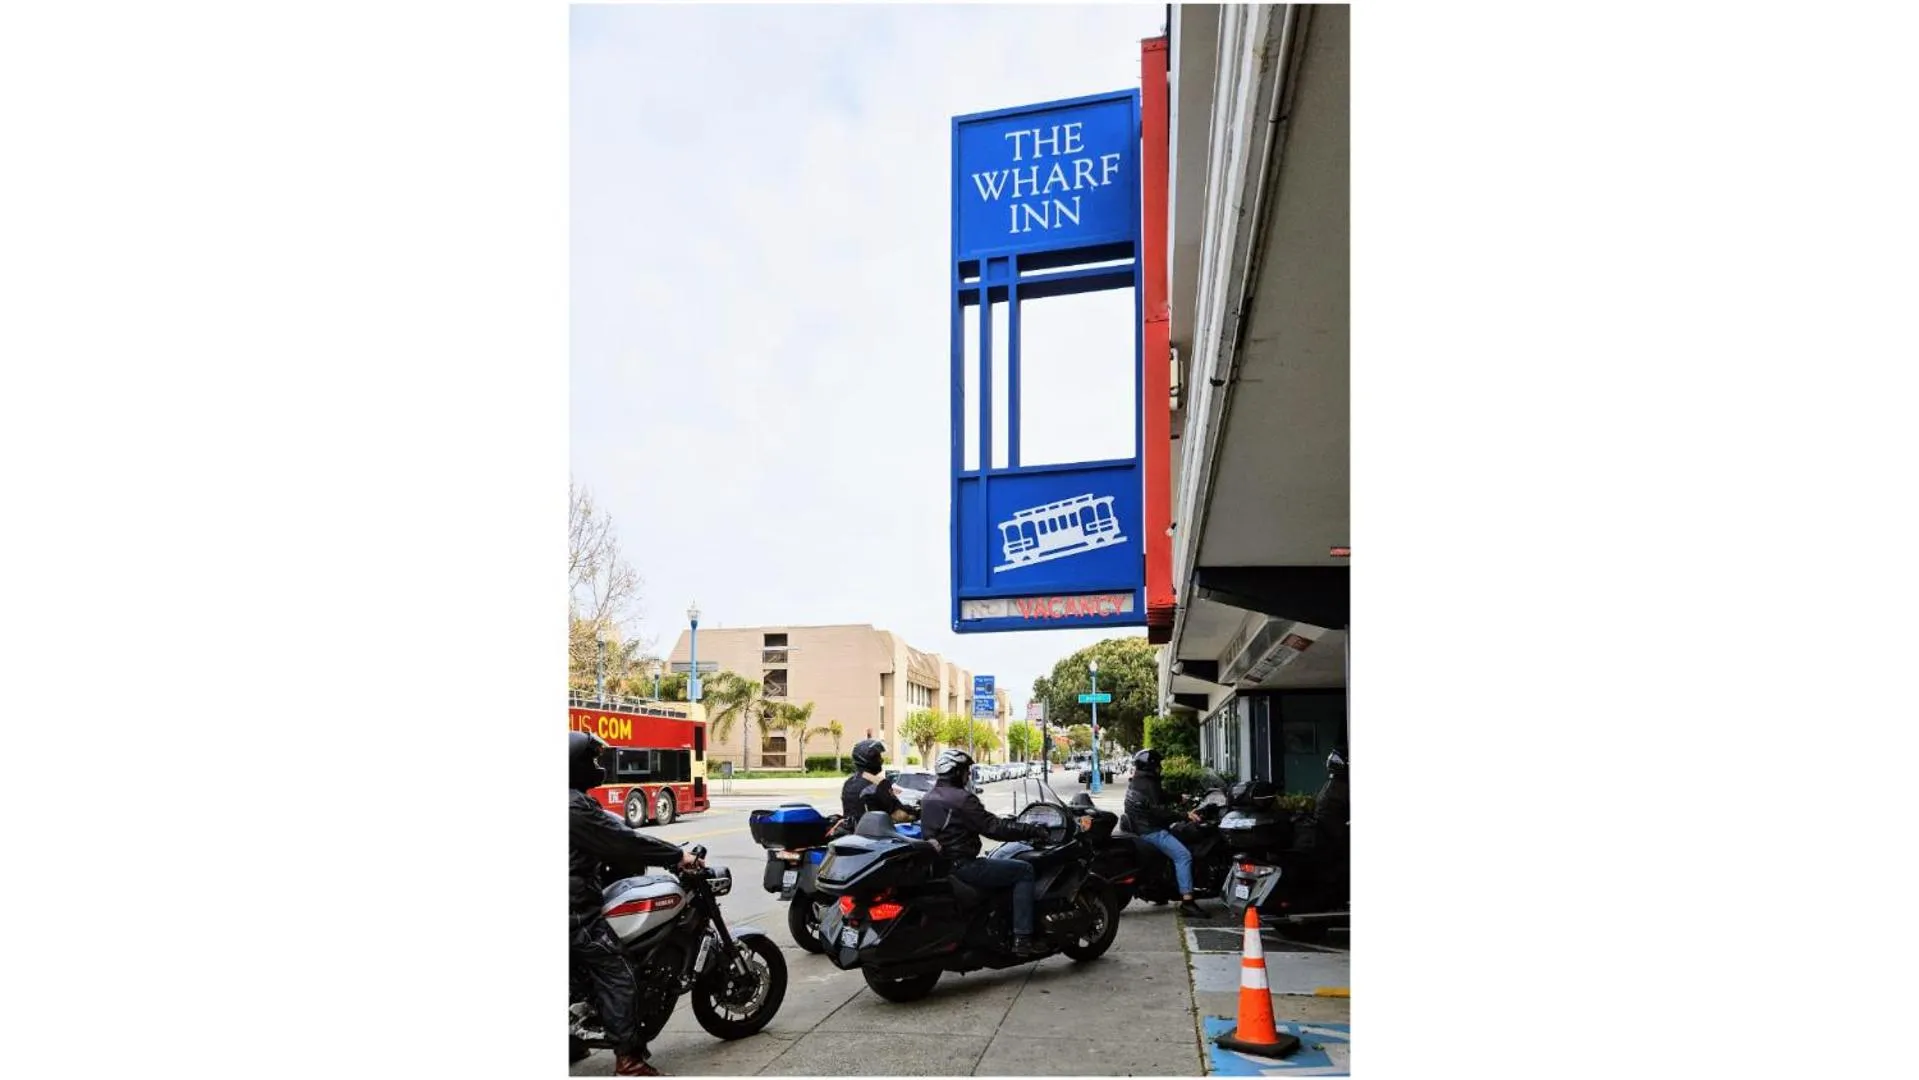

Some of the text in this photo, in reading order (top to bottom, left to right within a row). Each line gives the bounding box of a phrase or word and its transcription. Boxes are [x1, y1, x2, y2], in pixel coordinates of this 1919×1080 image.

[1005, 122, 1085, 162] THE
[972, 153, 1120, 203] WHARF
[1009, 196, 1081, 234] INN
[1016, 595, 1126, 619] VACANCY
